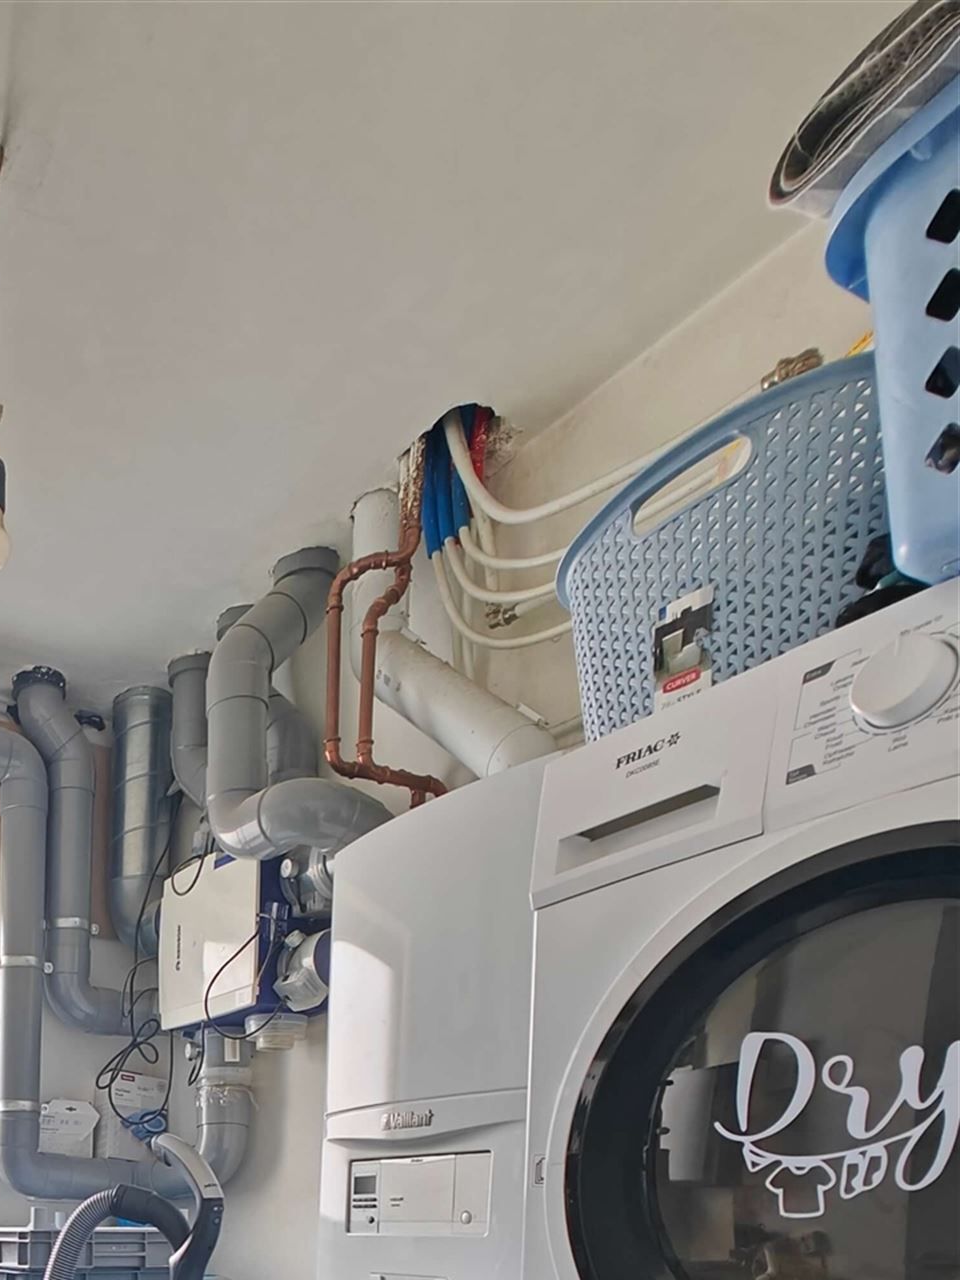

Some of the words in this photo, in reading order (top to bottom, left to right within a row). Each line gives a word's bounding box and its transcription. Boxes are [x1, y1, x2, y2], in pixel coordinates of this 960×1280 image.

[616, 739, 665, 769] FRIAC
[390, 1109, 434, 1130] Vaillant
[714, 1031, 960, 1191] Dry
